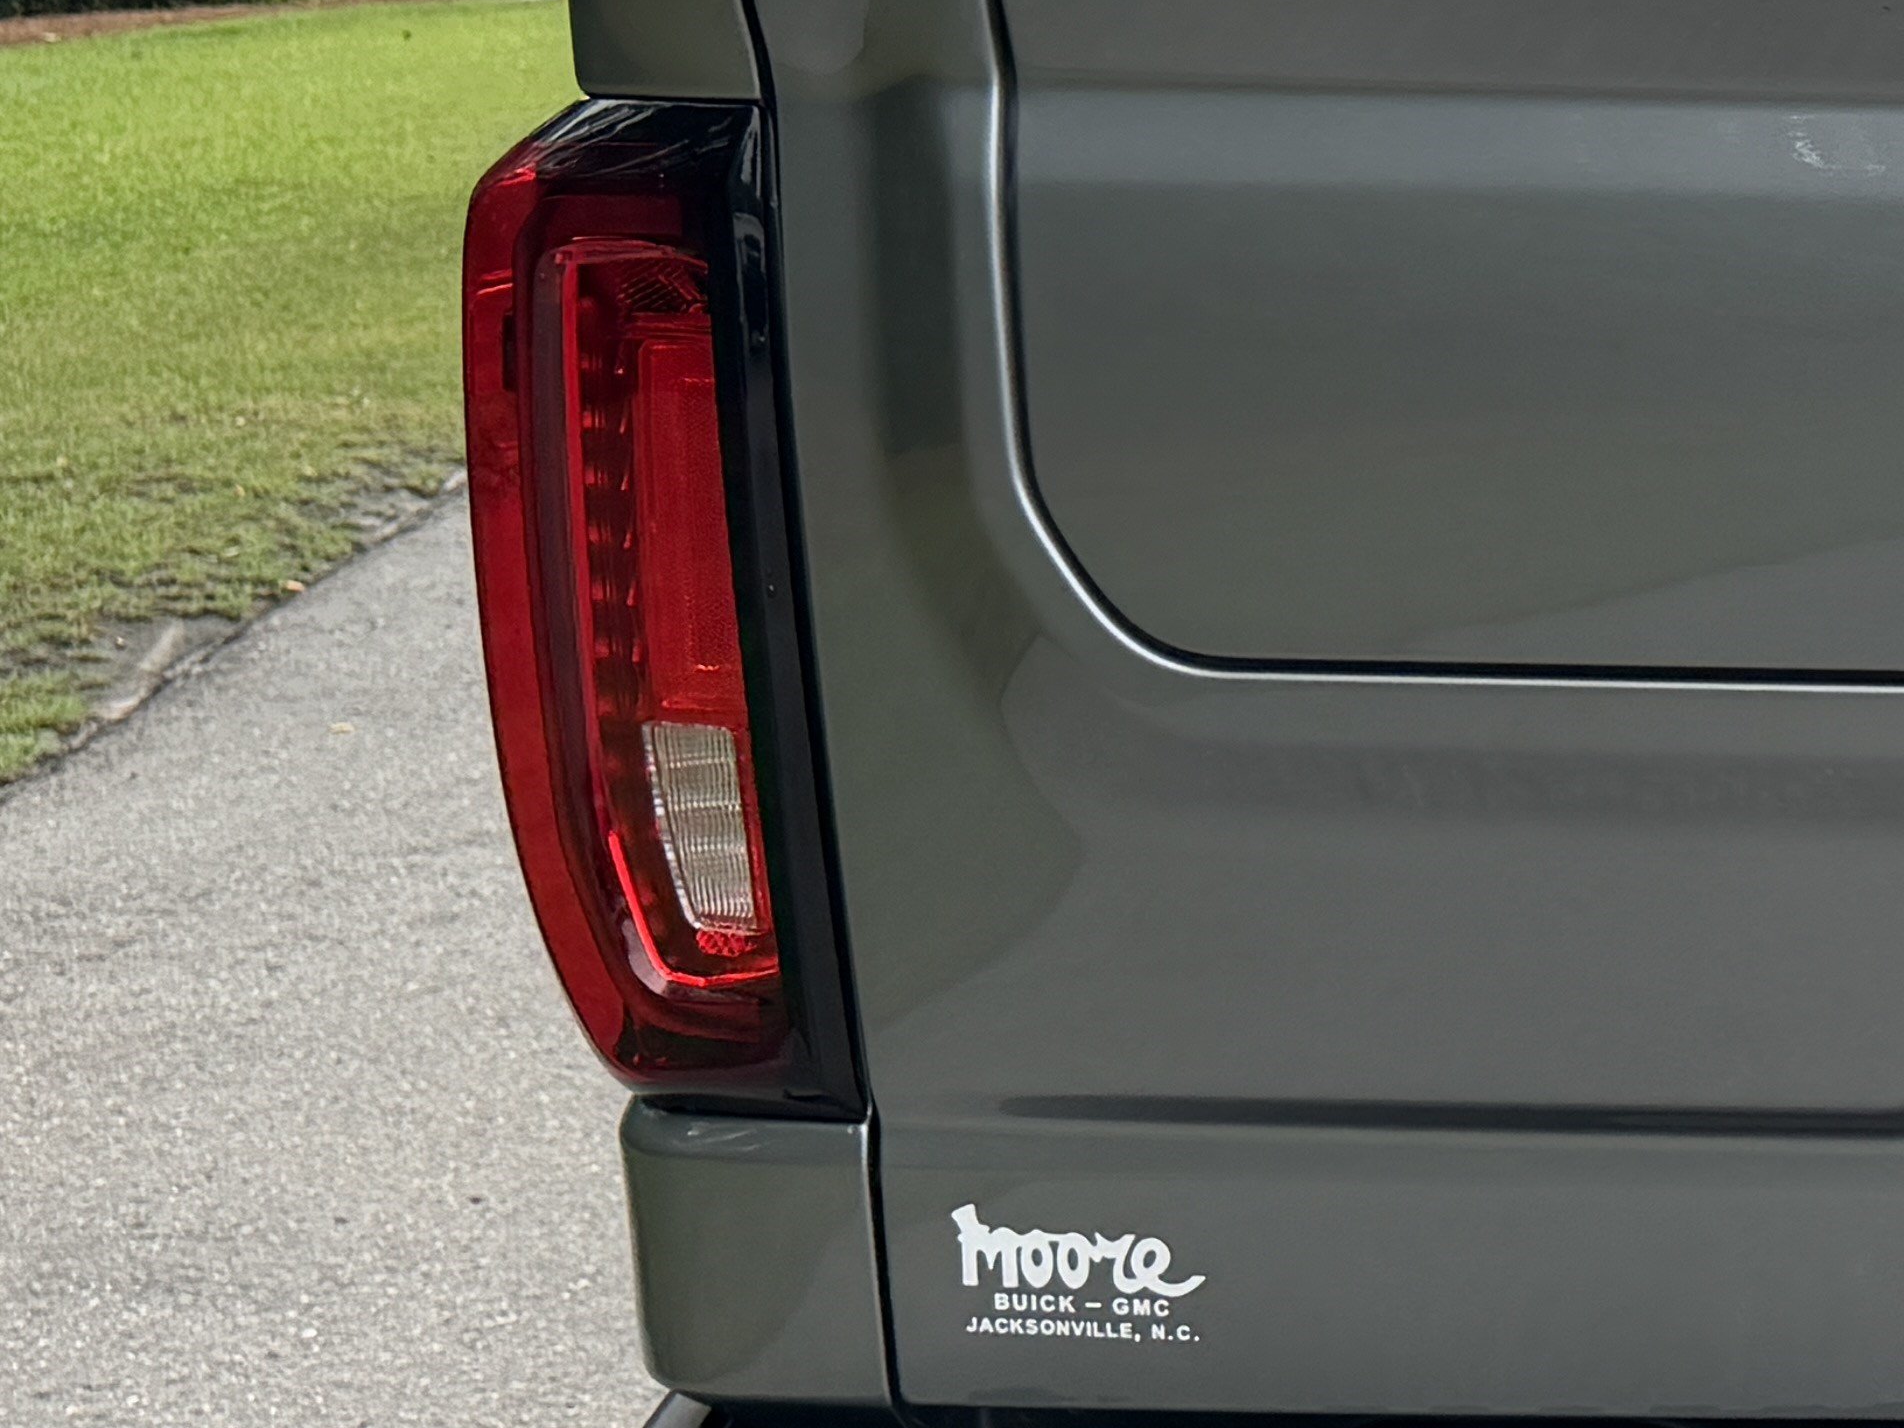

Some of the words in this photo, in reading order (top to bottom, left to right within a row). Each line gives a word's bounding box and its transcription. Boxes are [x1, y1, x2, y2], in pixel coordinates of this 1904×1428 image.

[994, 1292, 1076, 1313] BUICK
[1112, 1298, 1170, 1317] GMC
[966, 1317, 1141, 1343] JACKSONVILLE,
[1151, 1325, 1200, 1342] N.C.
